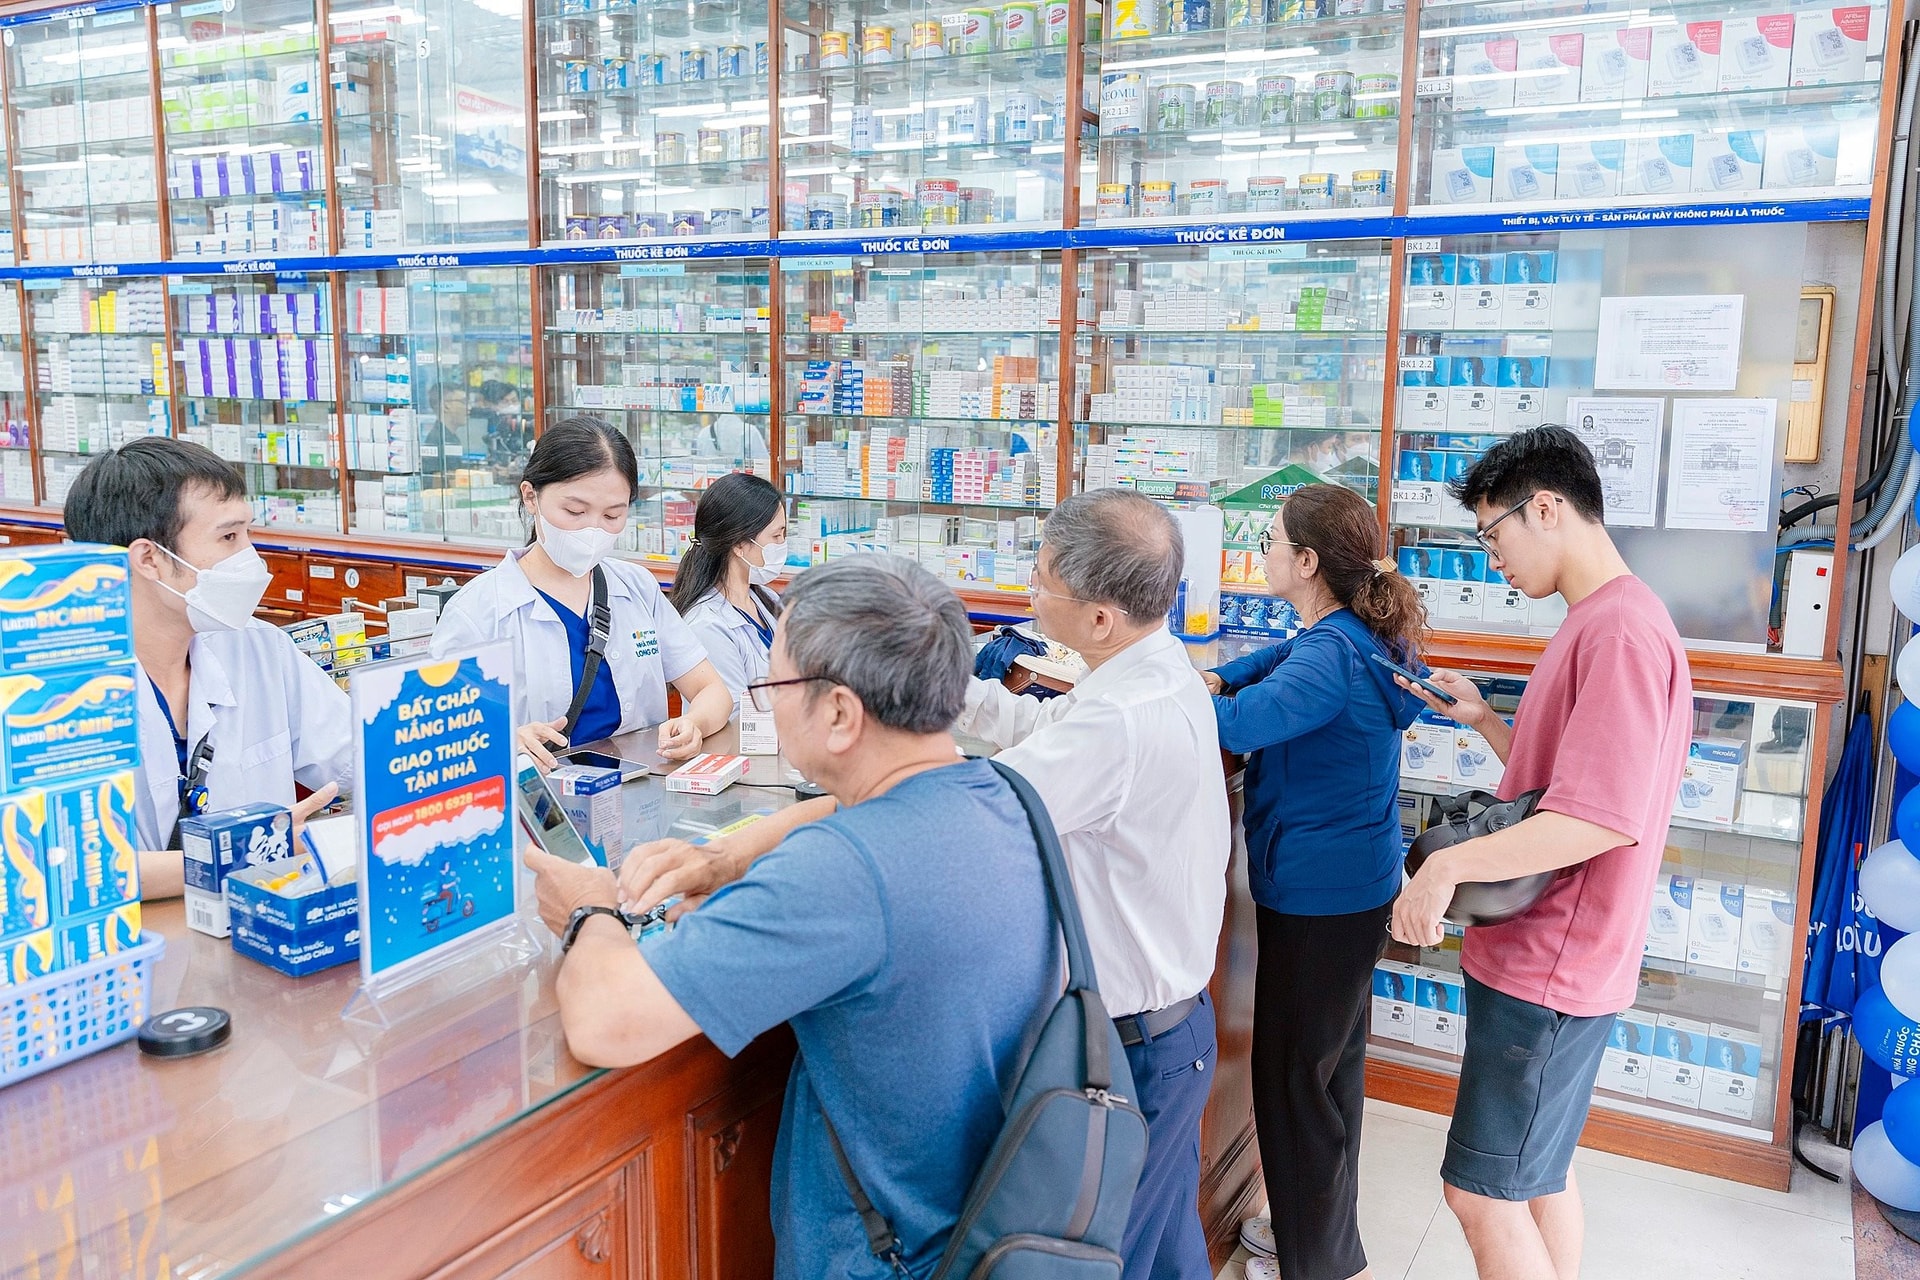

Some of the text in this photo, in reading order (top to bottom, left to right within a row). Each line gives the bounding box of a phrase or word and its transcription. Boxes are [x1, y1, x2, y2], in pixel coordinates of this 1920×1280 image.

[1418, 82, 1451, 93] BK1 1.3
[1118, 107, 1129, 115] 1.3
[1207, 190, 1214, 199] 2
[1502, 216, 1526, 226] THIẾT
[1542, 216, 1560, 226] VẬT
[1602, 213, 1622, 222] SẢN
[1652, 210, 1672, 220] NÀY
[1674, 209, 1708, 219] KHÔNG
[1710, 208, 1734, 218] PHẢI
[1736, 208, 1749, 217] LÀ
[1750, 206, 1785, 217] THUỐC
[1175, 226, 1285, 243] THUỐC KÊ ĐƠN
[861, 237, 950, 253] THUỐC KÊ ĐƠN
[1407, 242, 1439, 251] BK1 2.1
[615, 247, 648, 260] THUỐC
[666, 246, 689, 258] ĐƠN
[397, 254, 459, 267] THUỐC KÊ ĐƠN
[1400, 360, 1433, 369] BK1 2.2
[1393, 492, 1425, 501] BK1 2.3
[349, 570, 356, 586] 6
[636, 650, 651, 658] LONG
[398, 684, 481, 721] BẤT CHẤP
[394, 708, 485, 746] NẮNG MƯA
[388, 730, 490, 775] GIAO THUỐC
[1712, 749, 1737, 758] microlife
[404, 756, 478, 794] TẬN NHÀ
[415, 802, 444, 821] 1800
[445, 792, 474, 811] 6928
[1673, 891, 1689, 899] PAD
[1724, 900, 1740, 908] PAD
[1776, 907, 1791, 915] PAD
[1894, 1026, 1911, 1057] THUỐC
